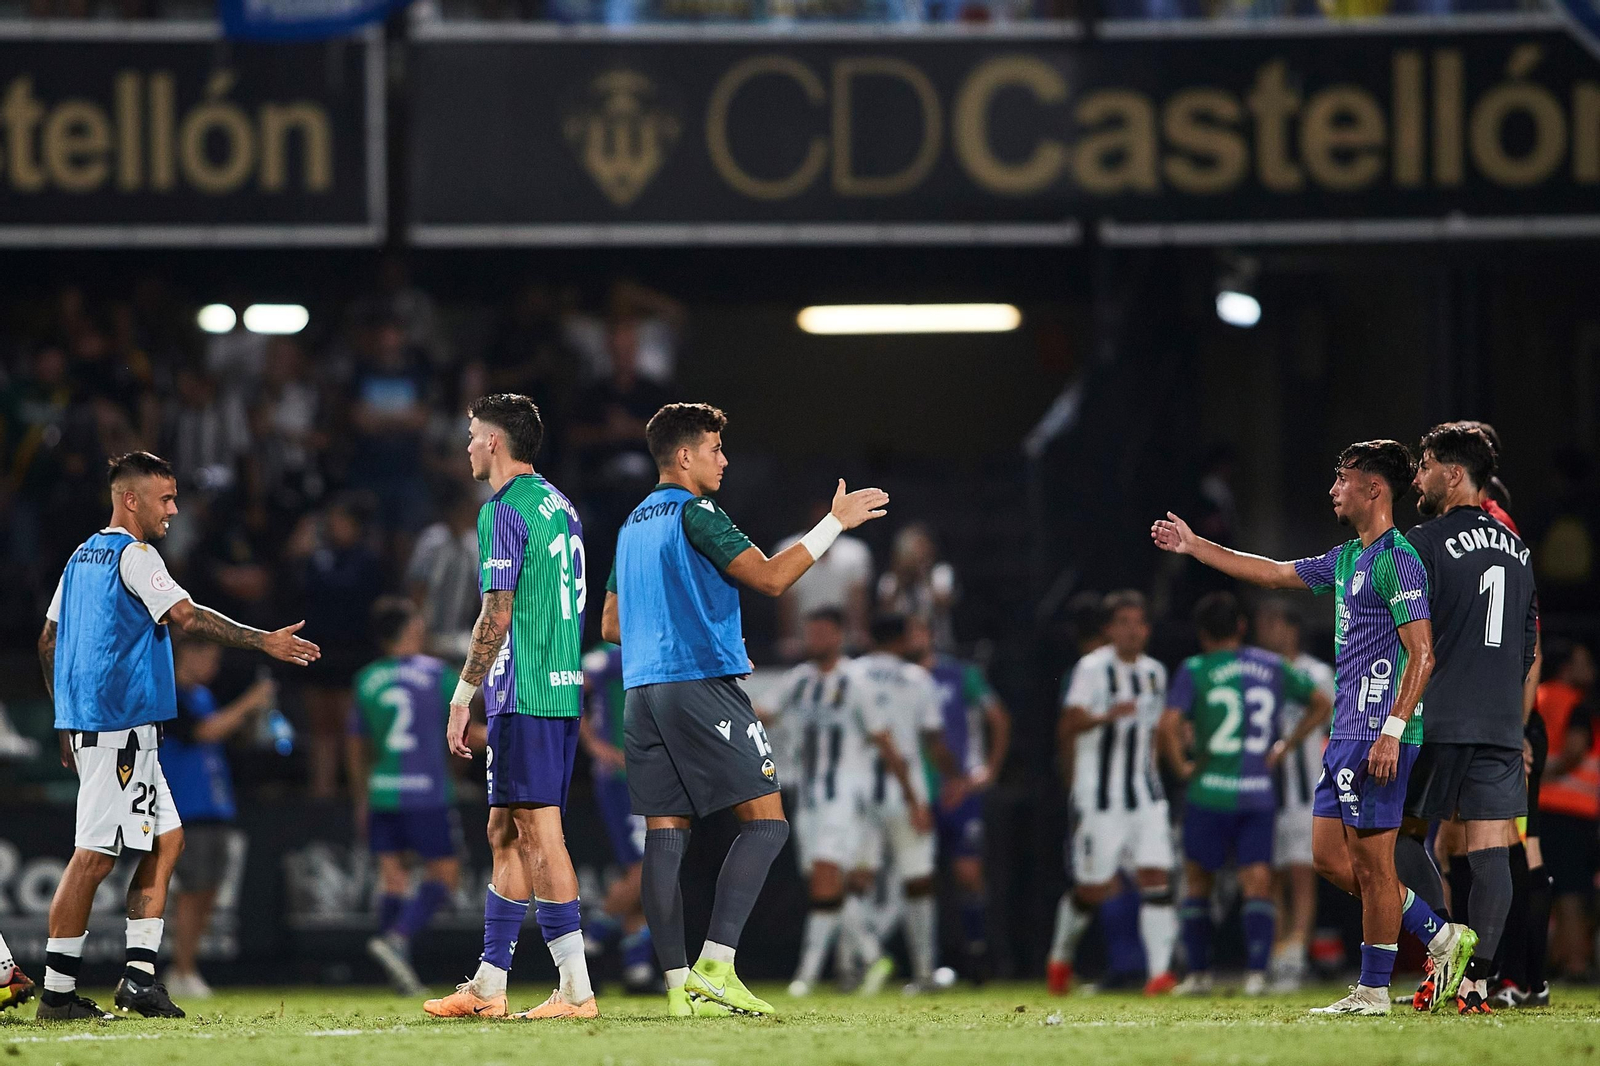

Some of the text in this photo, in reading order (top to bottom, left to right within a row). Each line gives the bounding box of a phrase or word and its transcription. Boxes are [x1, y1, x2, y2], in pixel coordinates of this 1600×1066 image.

[0, 69, 334, 193] tellón
[548, 533, 587, 619] 19
[1479, 565, 1505, 647] 1
[377, 685, 419, 751] 2
[1206, 685, 1275, 755] 23
[129, 781, 157, 818] 22
